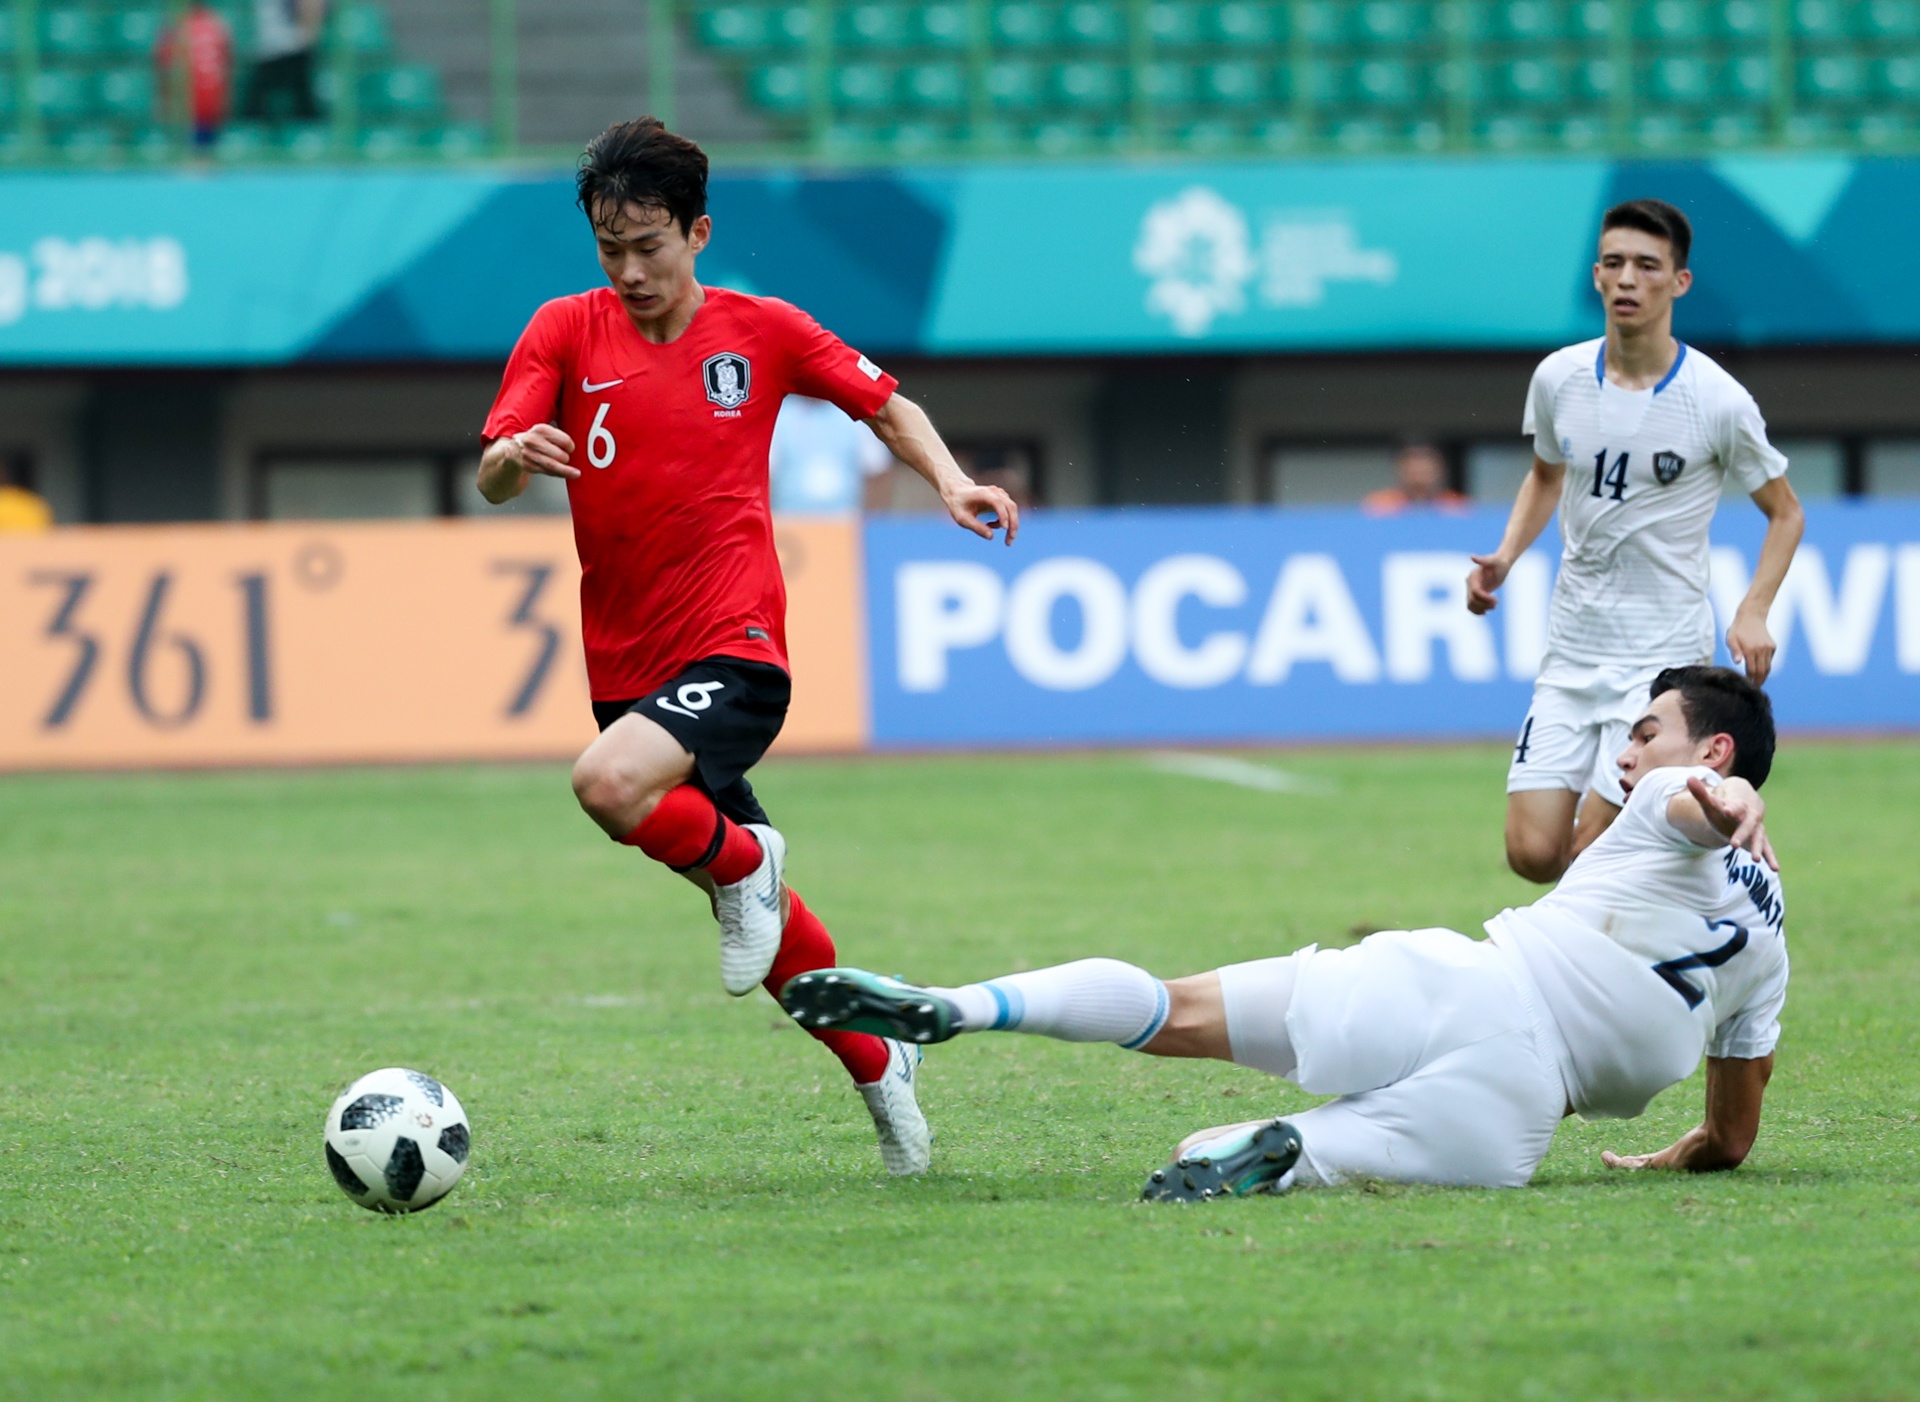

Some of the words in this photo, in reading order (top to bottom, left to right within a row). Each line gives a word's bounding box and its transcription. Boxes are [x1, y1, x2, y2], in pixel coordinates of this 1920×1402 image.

[587, 402, 616, 469] 6
[713, 410, 742, 418] KOREA
[1591, 448, 1630, 501] 14
[897, 549, 1548, 692] POCARI
[677, 680, 725, 711] 6
[1651, 919, 1749, 1012] 2
